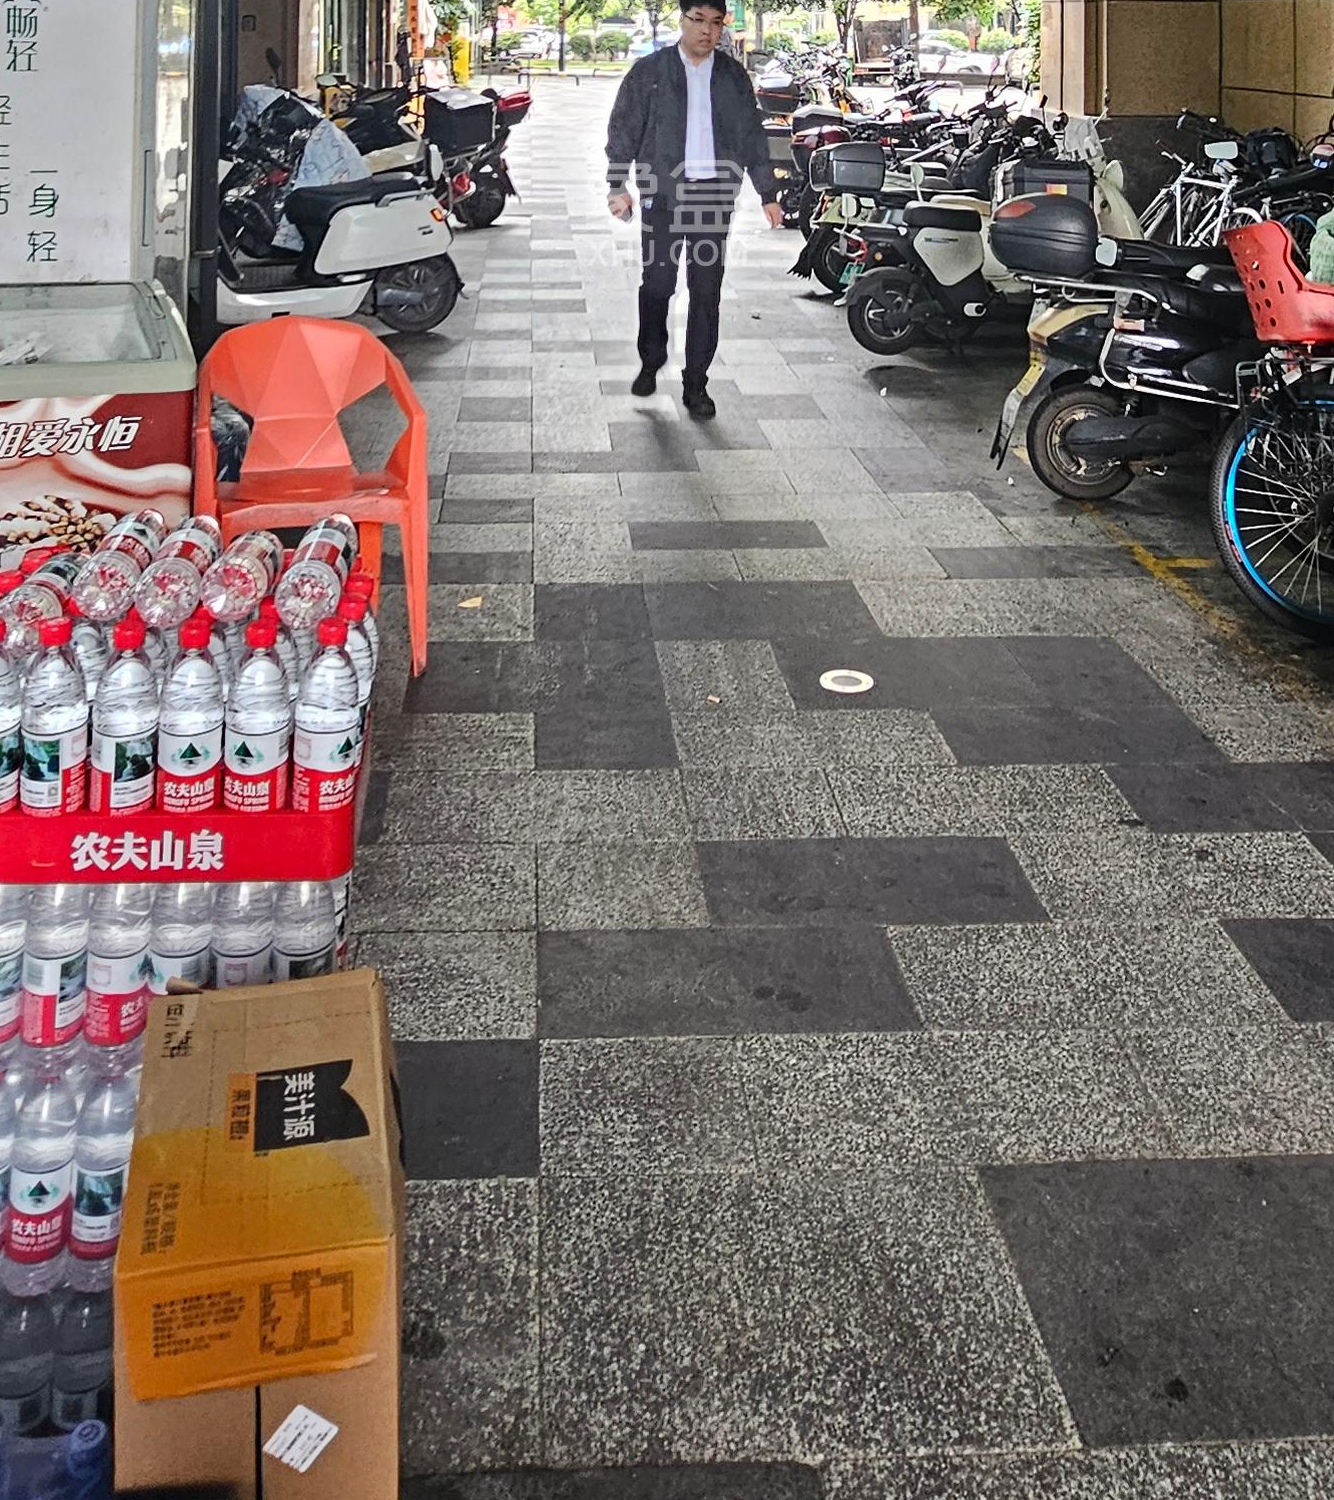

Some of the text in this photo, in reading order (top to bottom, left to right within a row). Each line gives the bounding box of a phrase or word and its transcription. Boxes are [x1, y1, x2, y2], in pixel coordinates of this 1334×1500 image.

[4, 4, 40, 74] 畅轻
[27, 167, 61, 266] 一身轻
[69, 829, 225, 872] 农夫山泉
[282, 1070, 316, 1141] 美汁源
